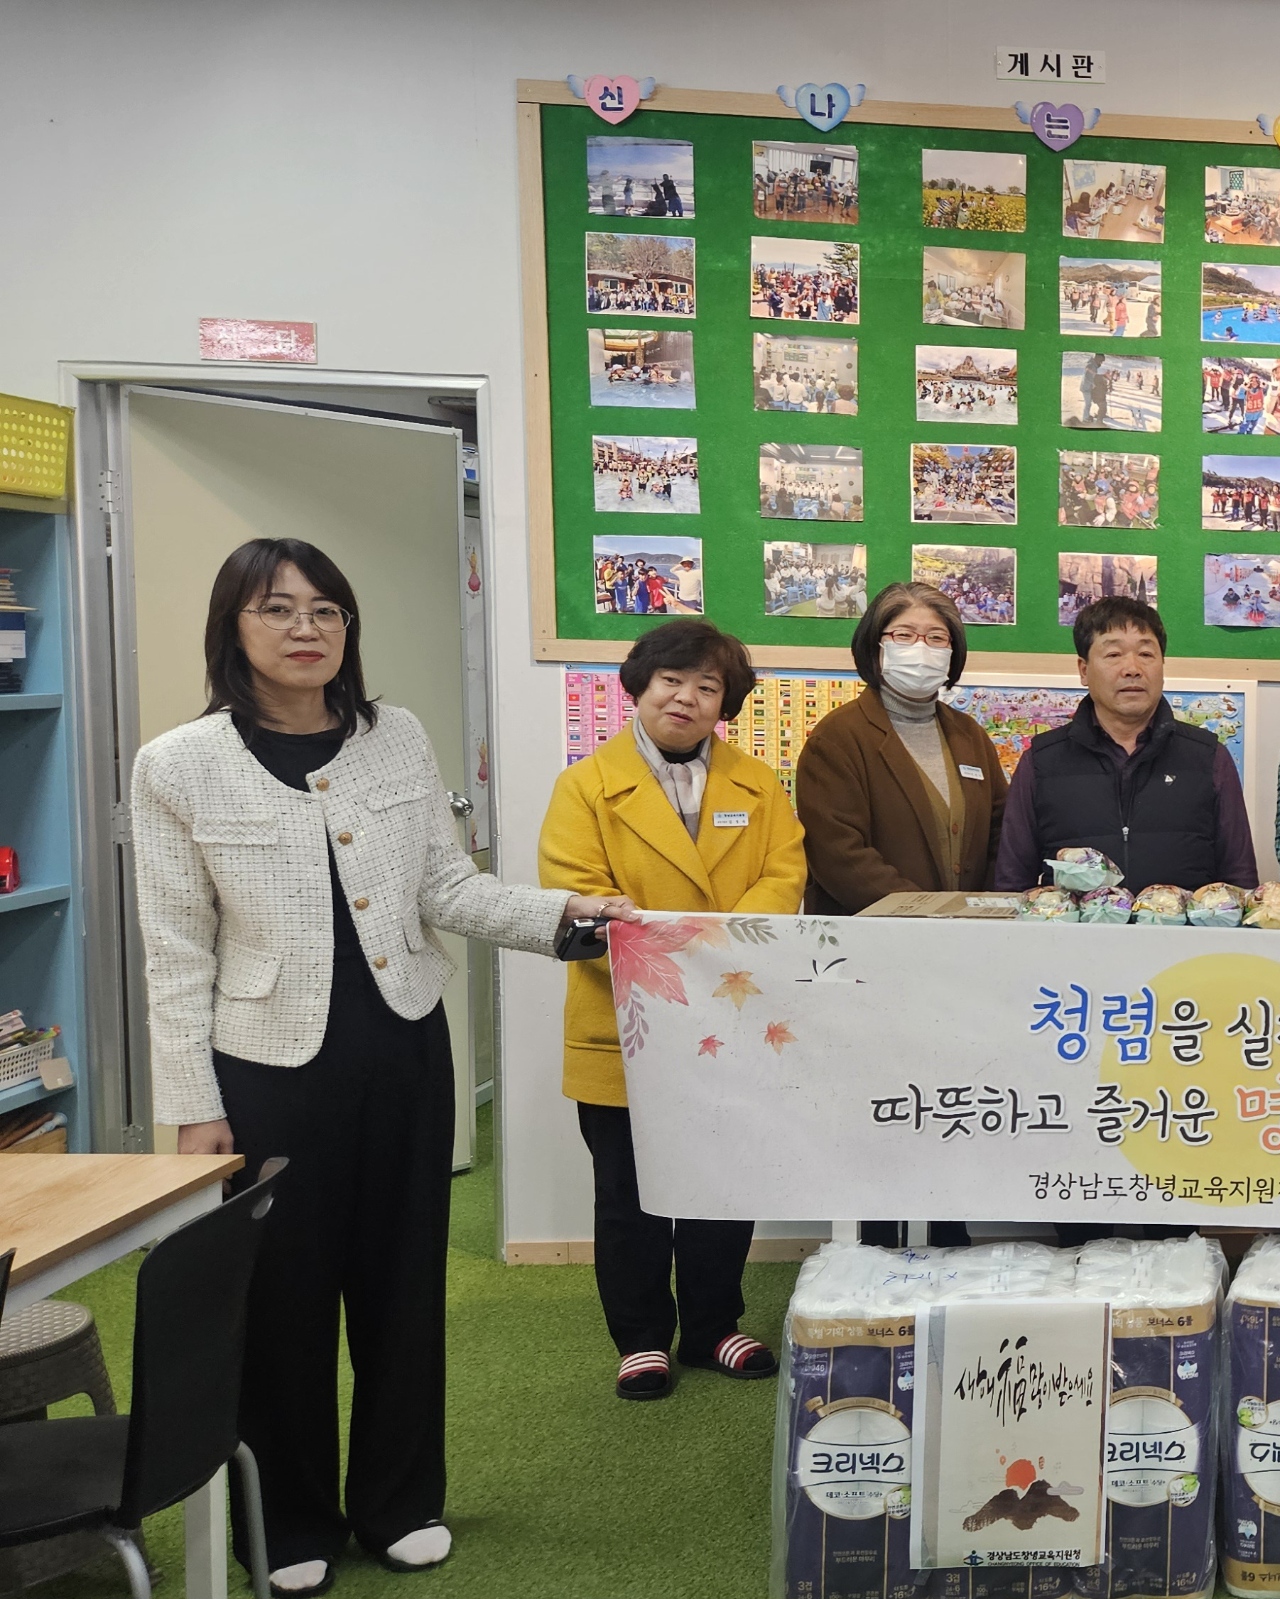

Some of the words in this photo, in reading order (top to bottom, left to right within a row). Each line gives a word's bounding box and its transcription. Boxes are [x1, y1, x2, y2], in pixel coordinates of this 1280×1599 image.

[1006, 50, 1095, 79] 게시판
[598, 84, 625, 112] 신
[809, 92, 837, 120] 나
[1044, 111, 1071, 140] 는
[1030, 984, 1209, 1063] 청렴을
[870, 1084, 1070, 1139] 따뜻하고
[1086, 1084, 1216, 1144] 즐거운
[866, 1327, 895, 1336] 보너스
[1146, 1316, 1175, 1327] 보너스
[1107, 1440, 1187, 1463] 크리넥스
[810, 1452, 906, 1475] 크리넥스
[986, 1549, 1082, 1561] 경상남도창녕교육지원청
